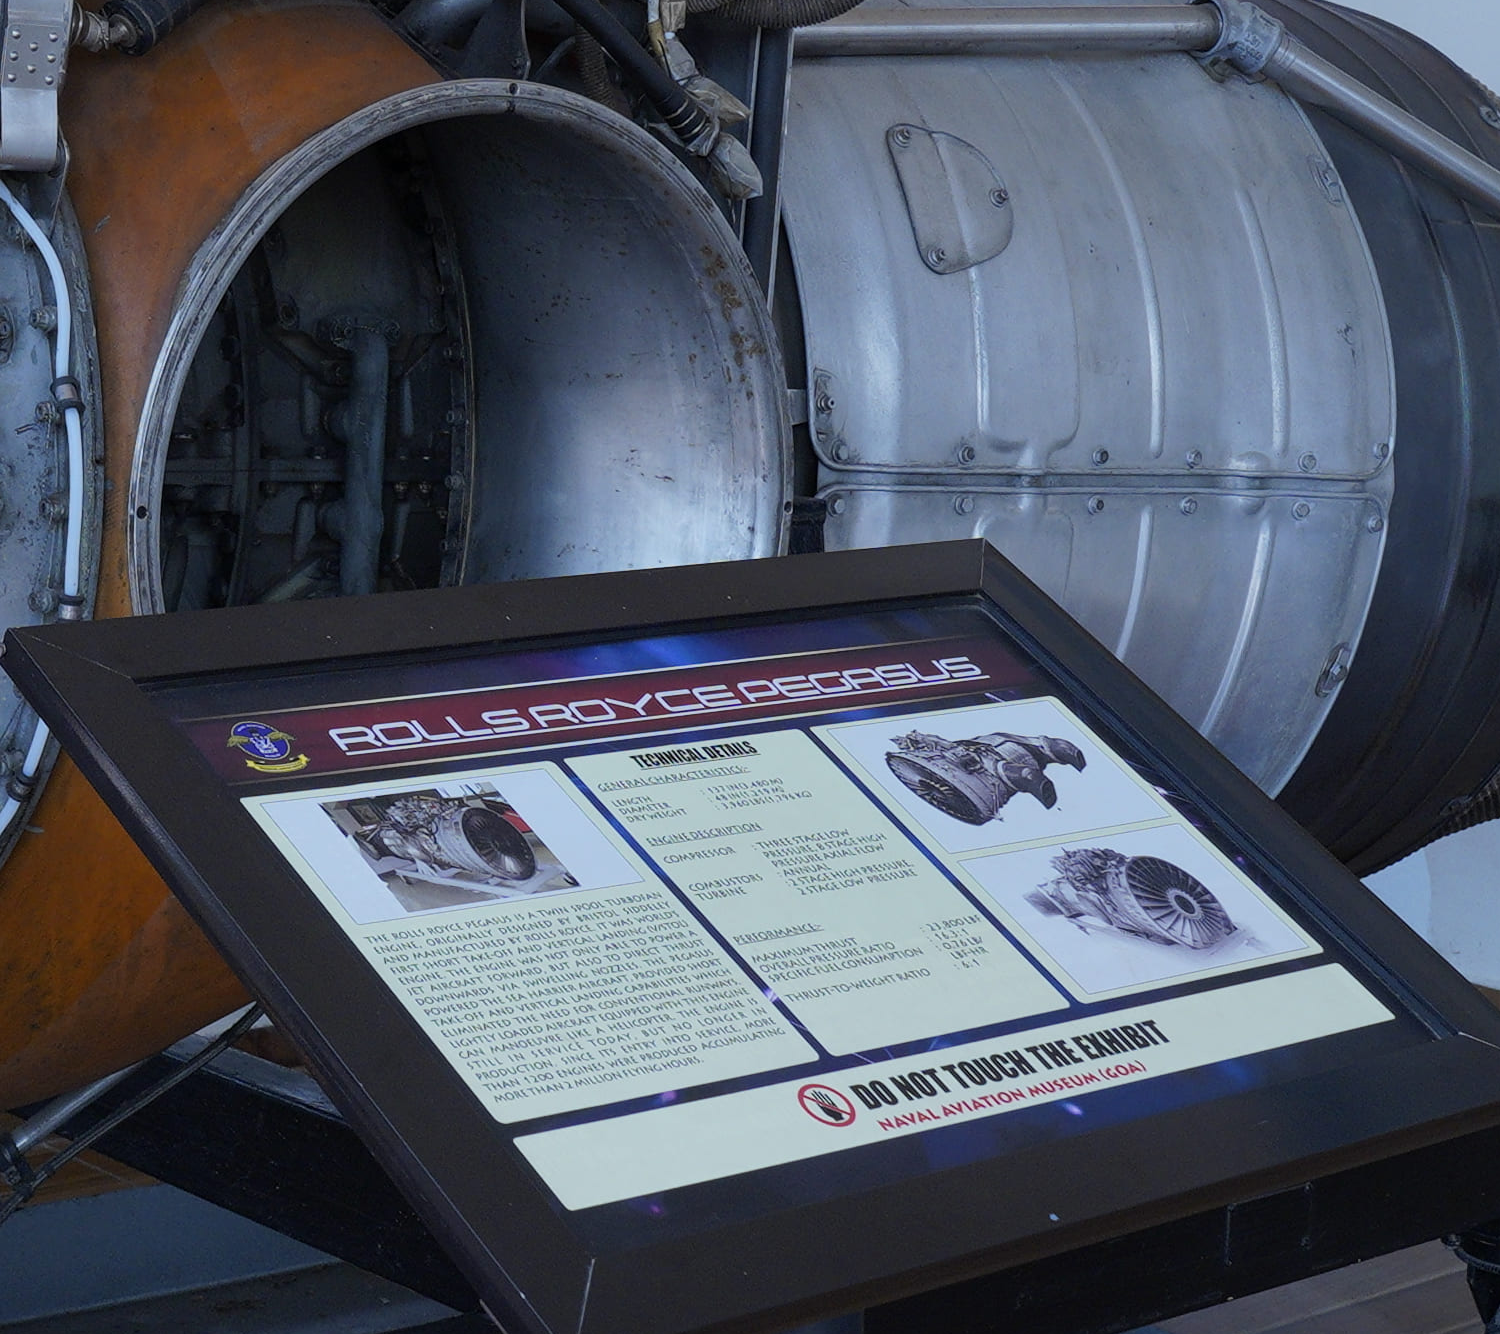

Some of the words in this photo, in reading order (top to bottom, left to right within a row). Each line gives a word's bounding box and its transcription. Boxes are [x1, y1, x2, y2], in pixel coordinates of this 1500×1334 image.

[328, 708, 530, 752] ROLLS
[528, 685, 742, 728] ROYCE
[736, 656, 982, 704] PEGASUS
[630, 748, 706, 768] TECHNICAL
[702, 741, 758, 759] DETAILS
[849, 1080, 899, 1110] DO
[889, 1068, 950, 1101] NOT
[942, 1050, 1036, 1088] TOUCH
[1026, 1039, 1084, 1070] THE
[1072, 1020, 1168, 1059] EXHIBIT
[877, 1109, 937, 1131] NAVAL
[940, 1088, 1026, 1117] AVIATION
[1027, 1073, 1100, 1097] MUSEUM
[1098, 1060, 1147, 1080] (GOA)
